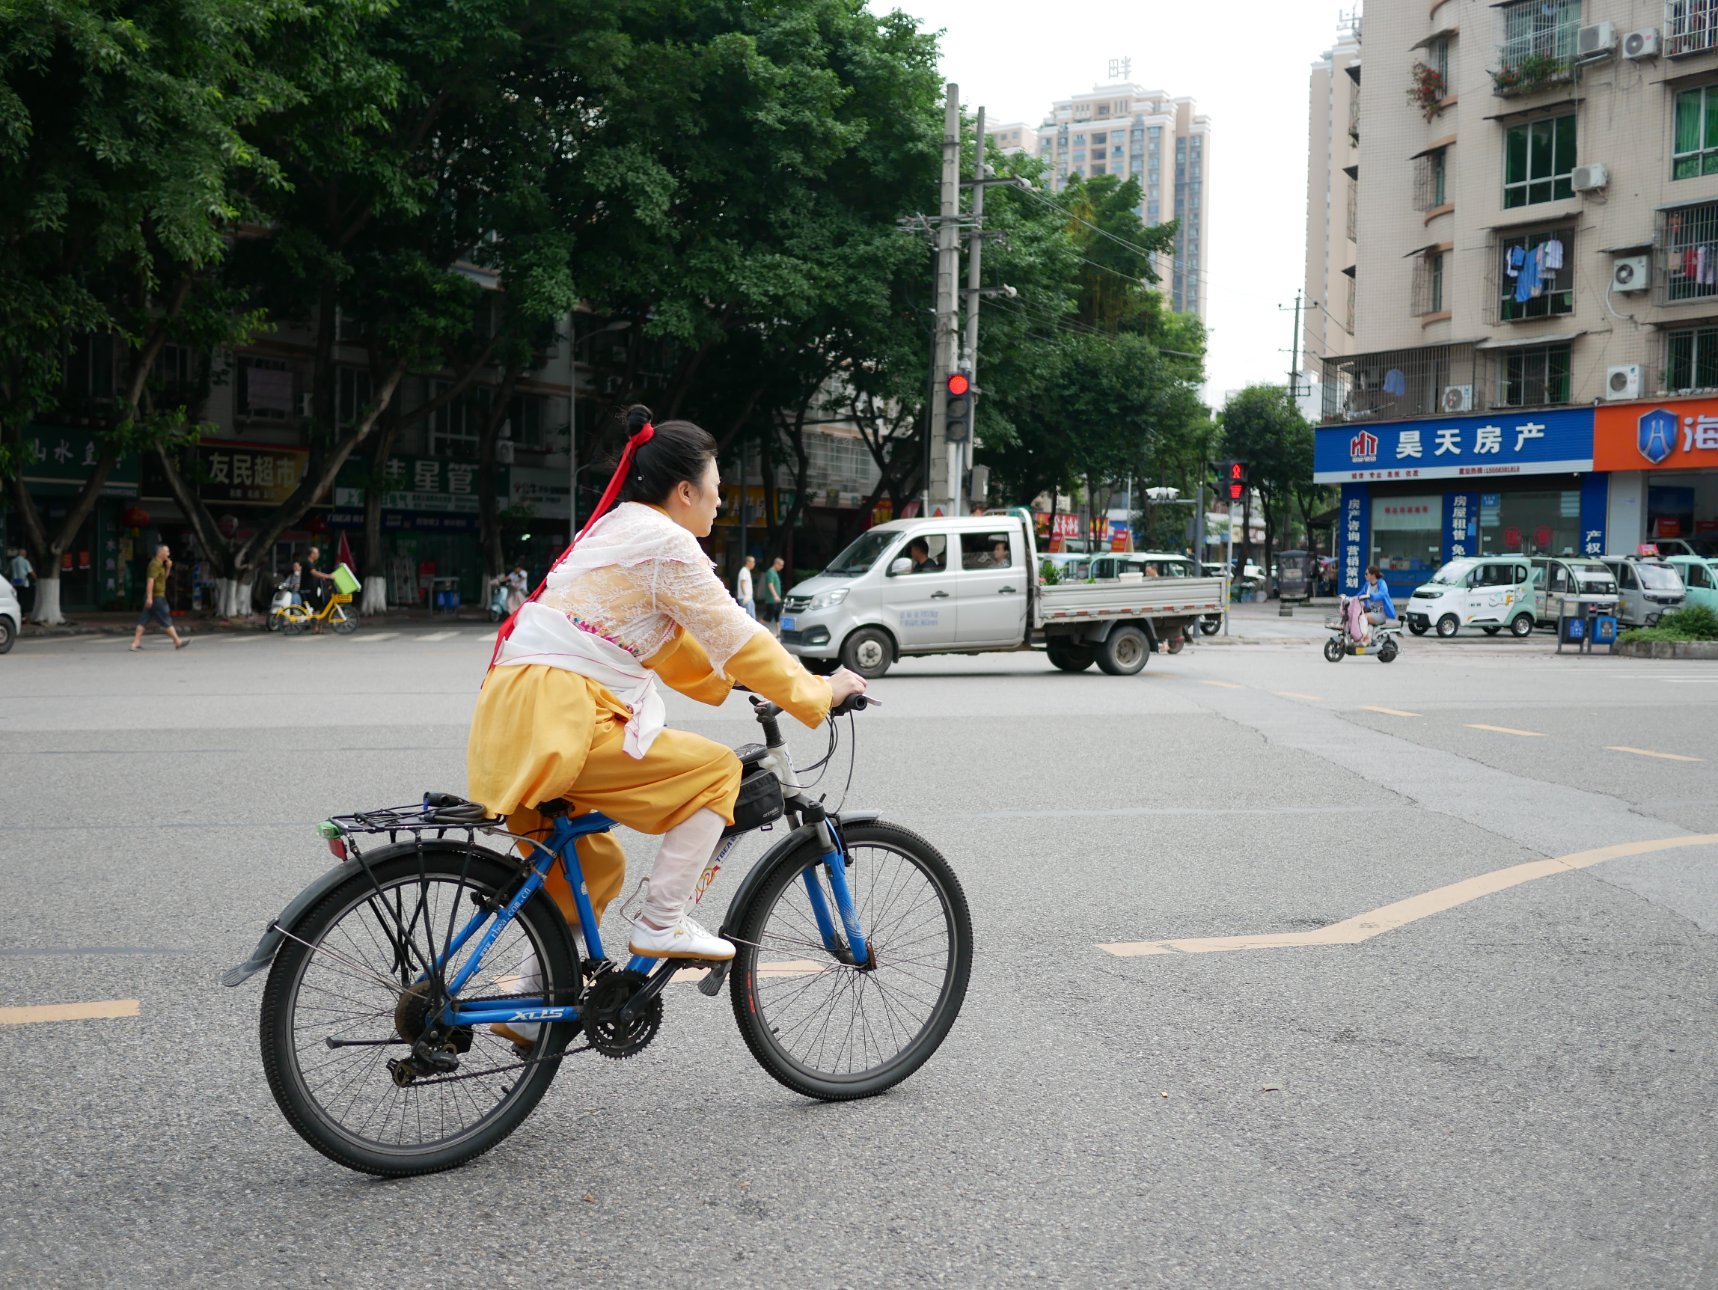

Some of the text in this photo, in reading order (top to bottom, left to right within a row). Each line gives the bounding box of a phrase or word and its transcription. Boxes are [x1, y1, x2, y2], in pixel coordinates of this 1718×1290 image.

[1395, 422, 1546, 459] 昊天房产
[208, 451, 296, 488] 友民超市
[1345, 498, 1361, 589] 房产咨询 营销策划
[1451, 495, 1468, 561] 房屋租售 免
[1585, 530, 1602, 559] 产权
